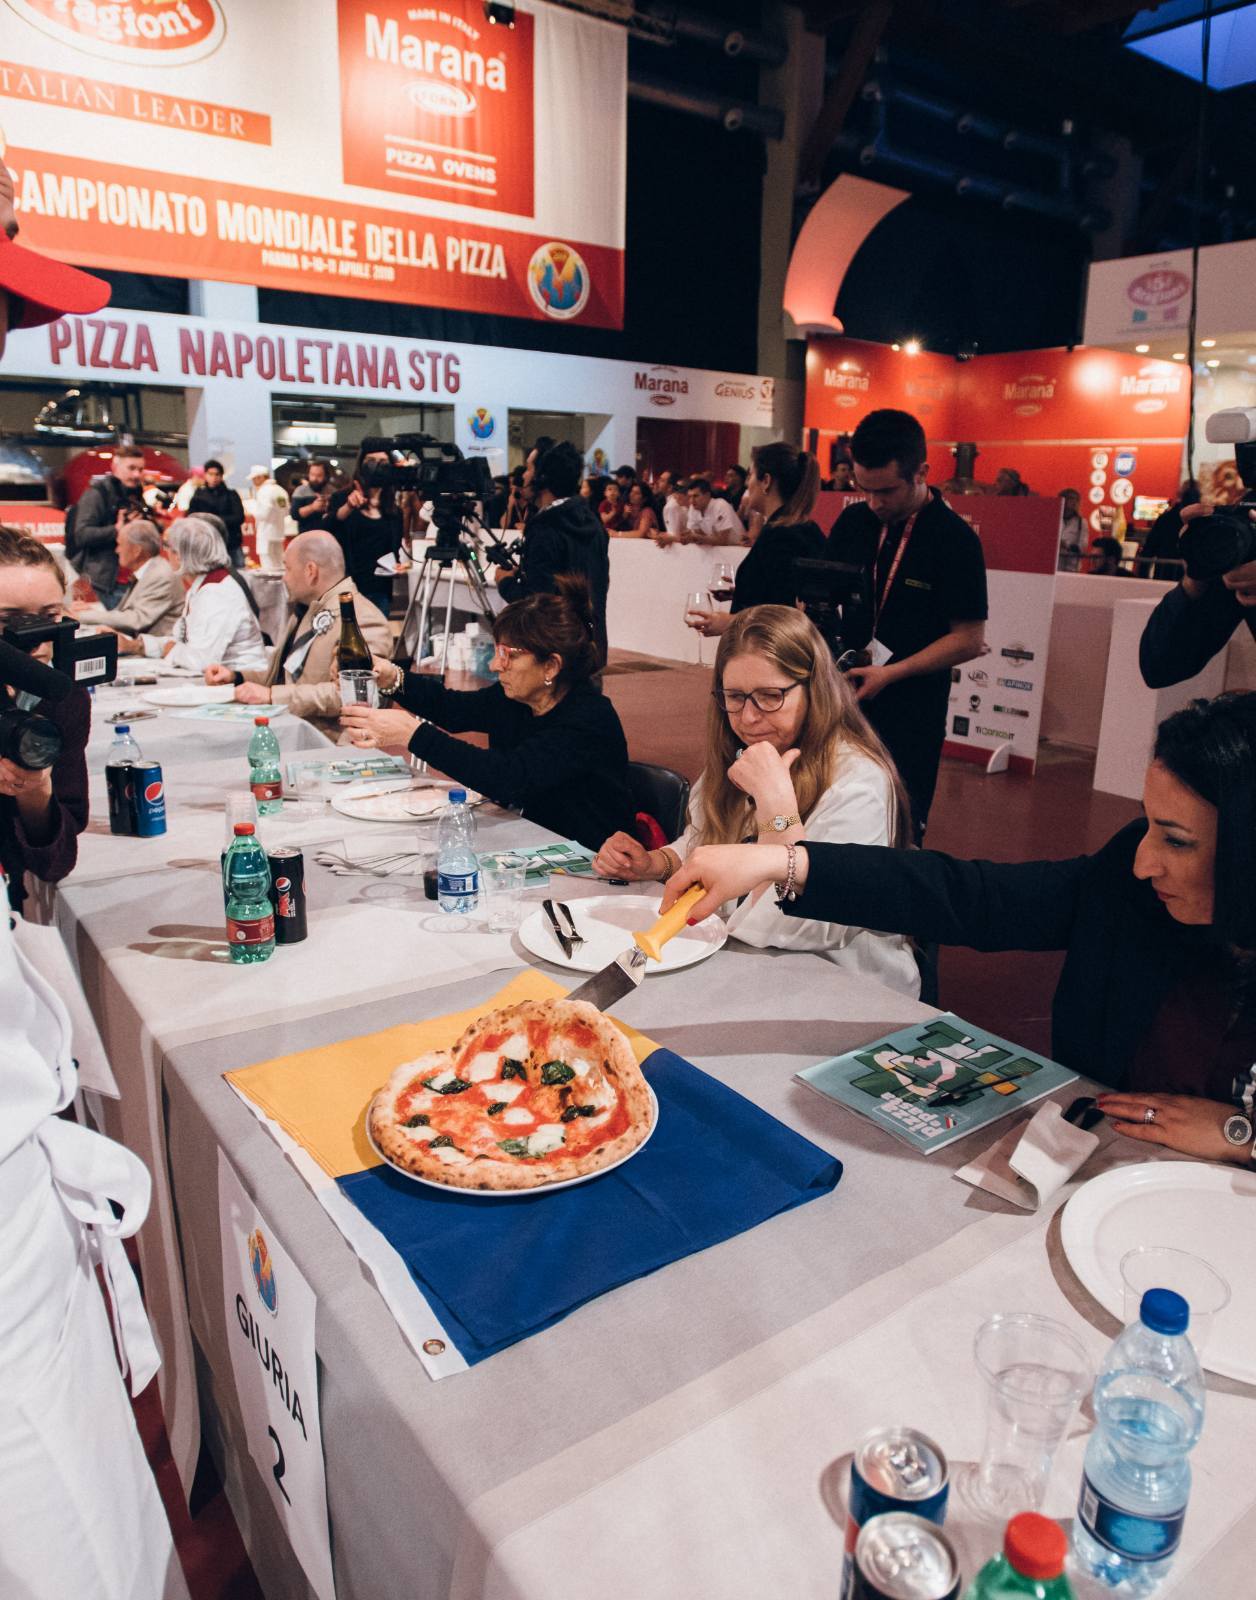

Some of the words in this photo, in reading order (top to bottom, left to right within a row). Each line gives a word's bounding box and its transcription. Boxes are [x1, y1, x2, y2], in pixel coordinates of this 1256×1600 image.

[365, 12, 507, 92] Marana
[132, 92, 246, 136] LEADER
[386, 147, 436, 172] PIZZA
[443, 159, 497, 184] OVENS
[216, 199, 358, 258] MONDIALE
[365, 223, 439, 271] DELLA
[446, 236, 507, 279] PIZZA
[49, 317, 159, 373] PIZZA
[179, 327, 402, 391] NAPOLETANA
[634, 371, 689, 394] Marana
[823, 367, 869, 391] Marana
[1004, 382, 1055, 401] Marana
[1119, 375, 1182, 396] Marana
[235, 1293, 308, 1442] GIURIA
[268, 1424, 292, 1506] 2
